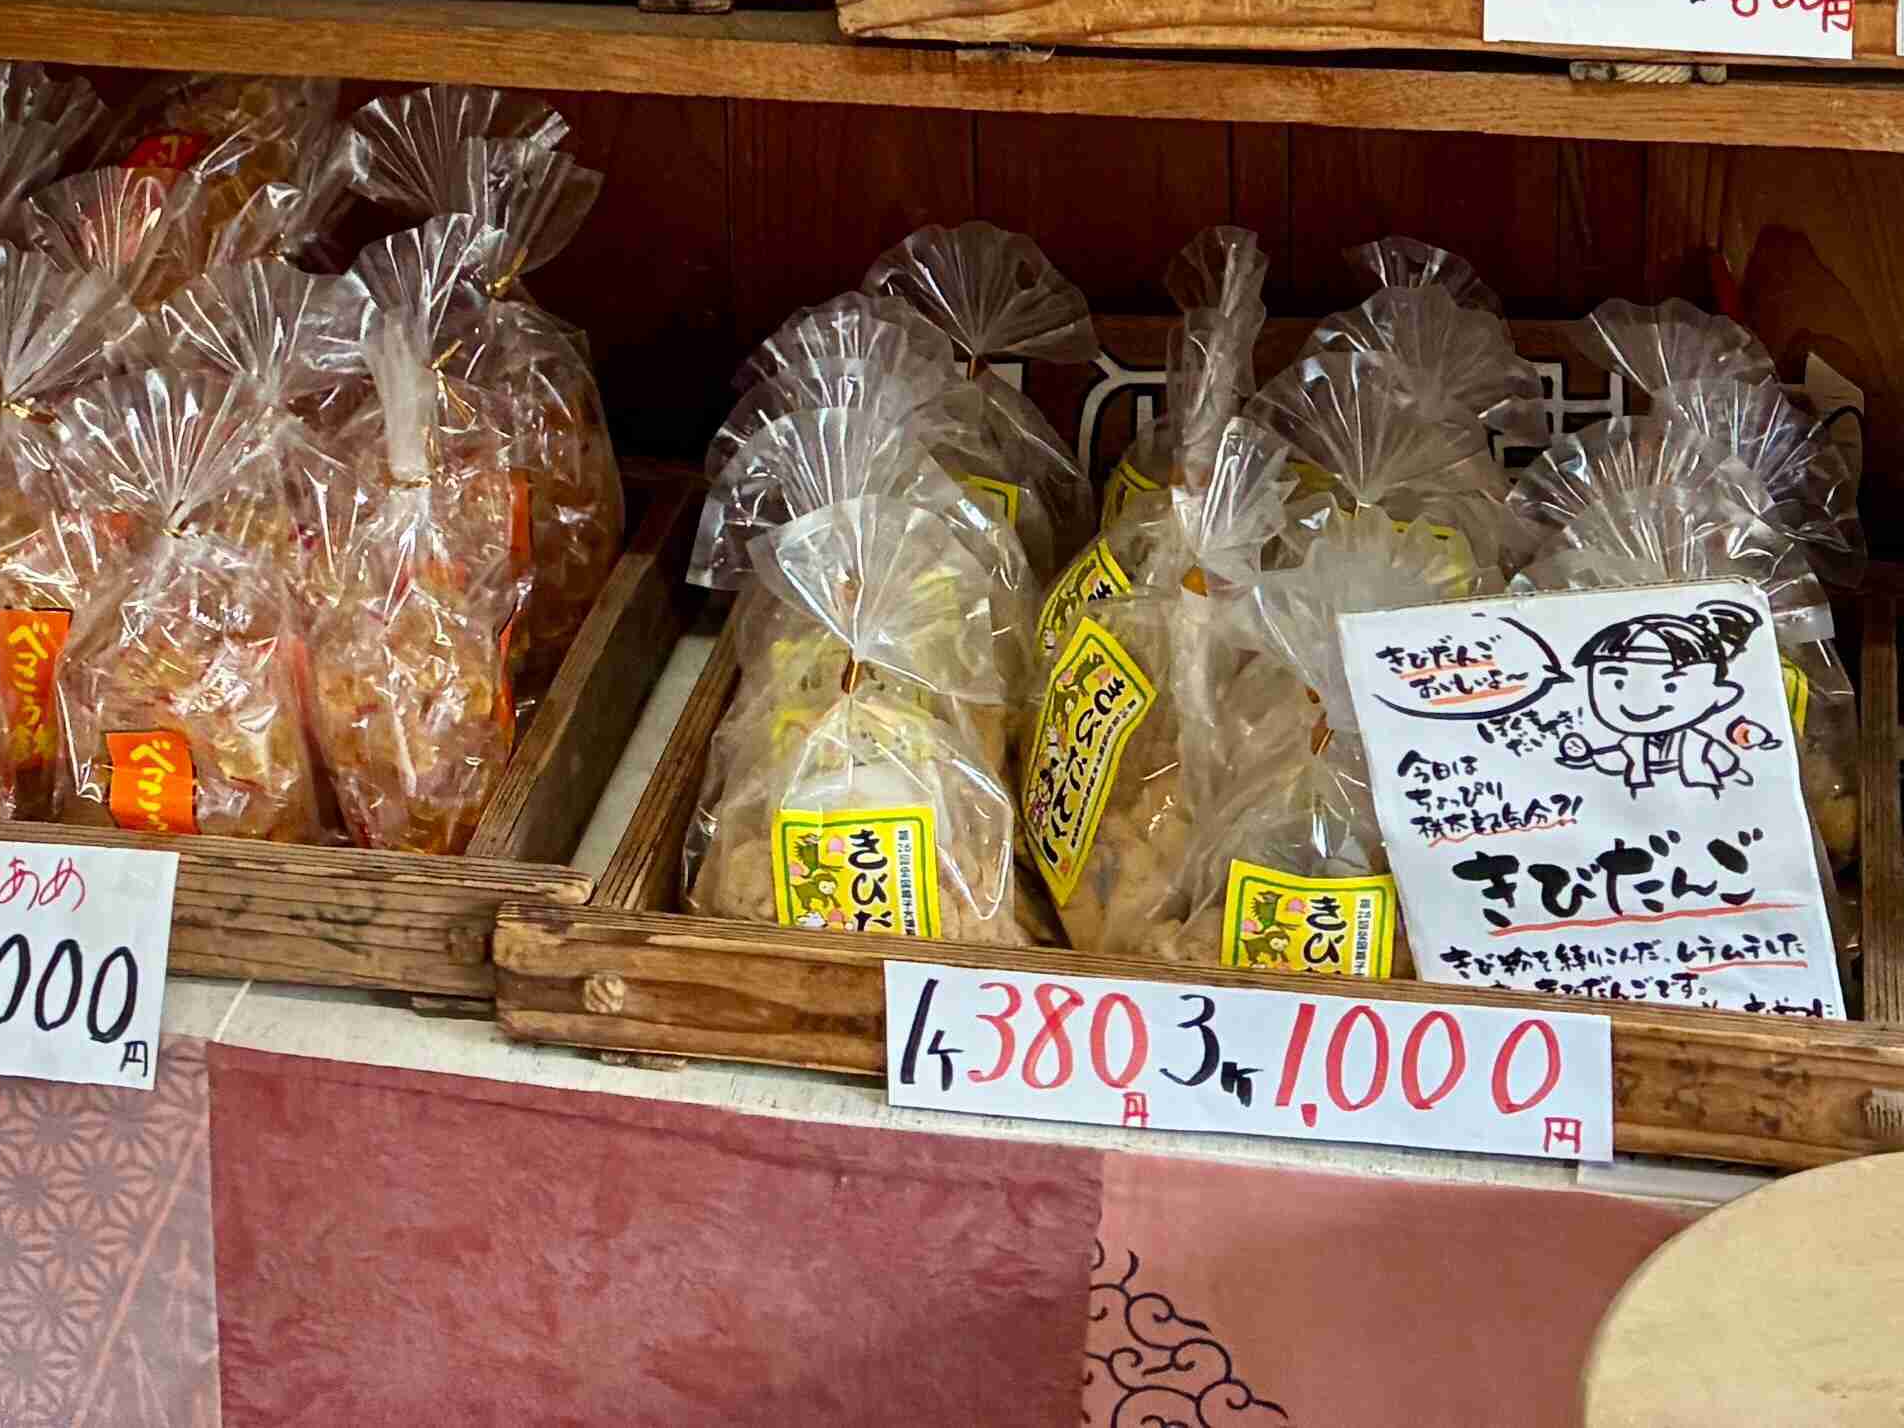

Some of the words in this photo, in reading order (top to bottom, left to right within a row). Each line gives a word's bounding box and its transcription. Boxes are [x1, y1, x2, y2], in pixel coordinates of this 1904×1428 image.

[1375, 633, 1502, 674] きびだんご
[1040, 677, 1127, 866] きびだんご
[1397, 749, 1479, 784] 今日は
[1405, 781, 1503, 813] ちょっぴり
[1451, 829, 1765, 929] きびだんご
[1303, 895, 1347, 964] きび
[967, 981, 1151, 1128] 380円
